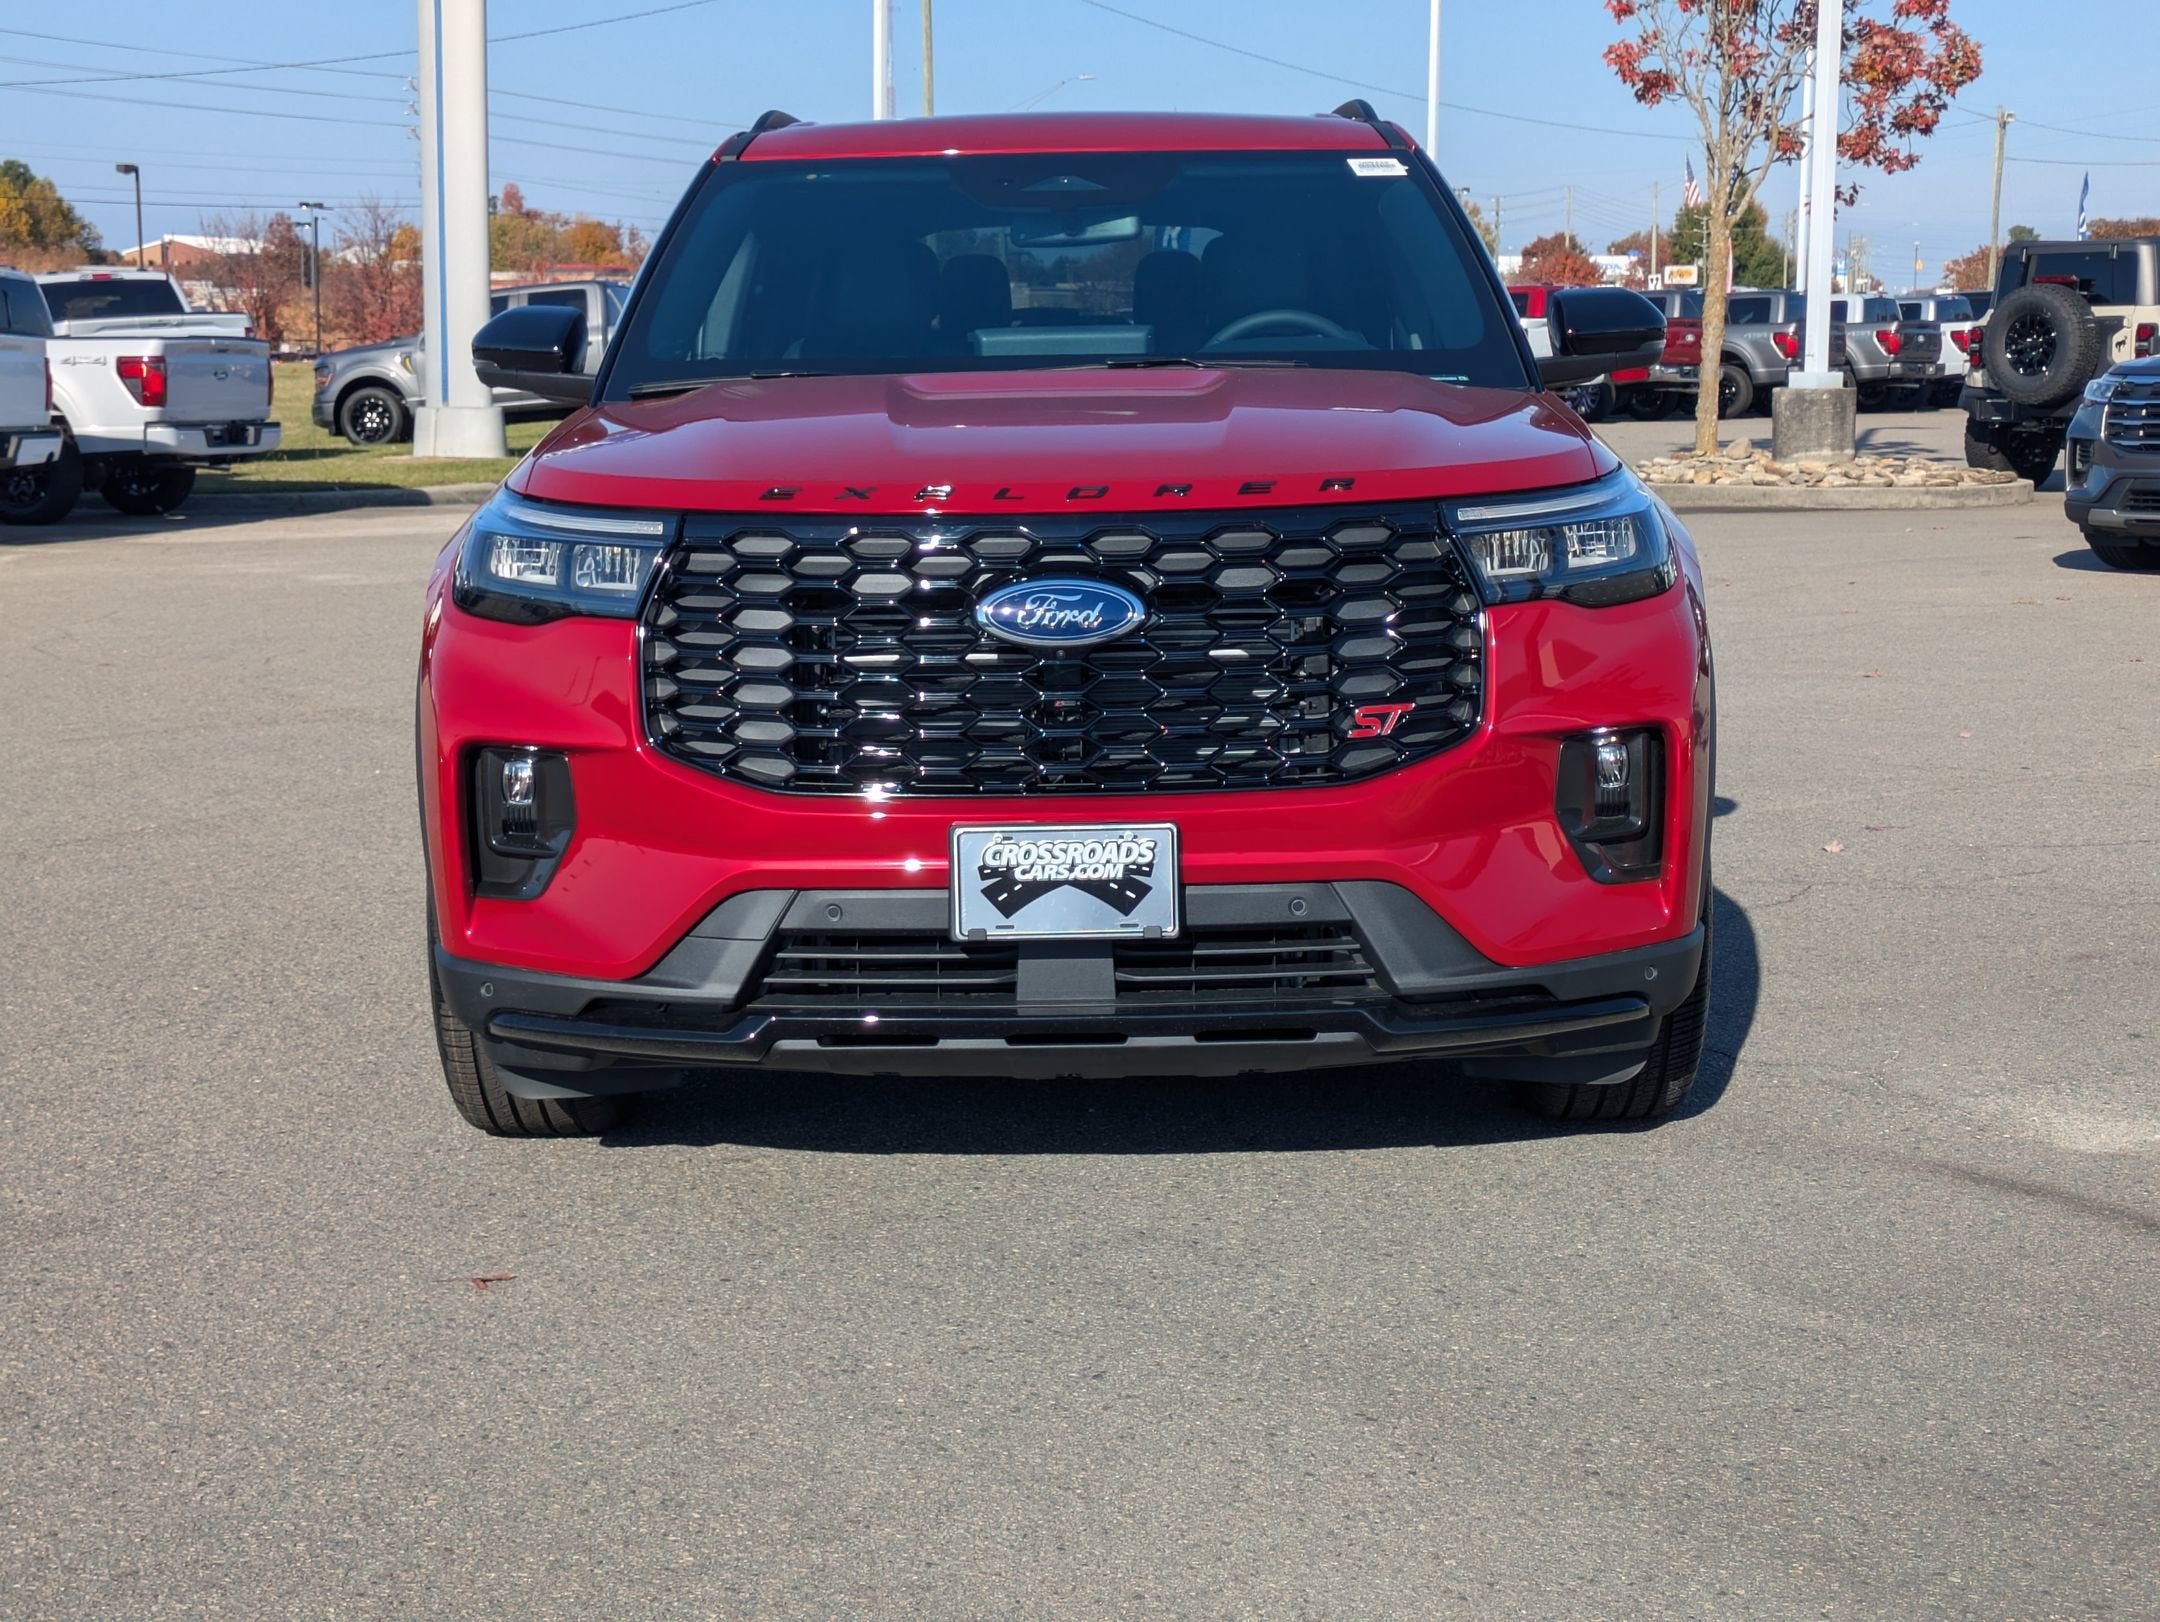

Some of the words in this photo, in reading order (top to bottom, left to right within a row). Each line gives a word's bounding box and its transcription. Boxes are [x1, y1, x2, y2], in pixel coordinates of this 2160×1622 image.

[758, 477, 1356, 503] EXPLORER
[1016, 592, 1105, 630] Ford
[1346, 702, 1416, 739] ST
[981, 837, 1158, 868] CROSSROADS
[1013, 862, 1125, 882] CARS.COM
